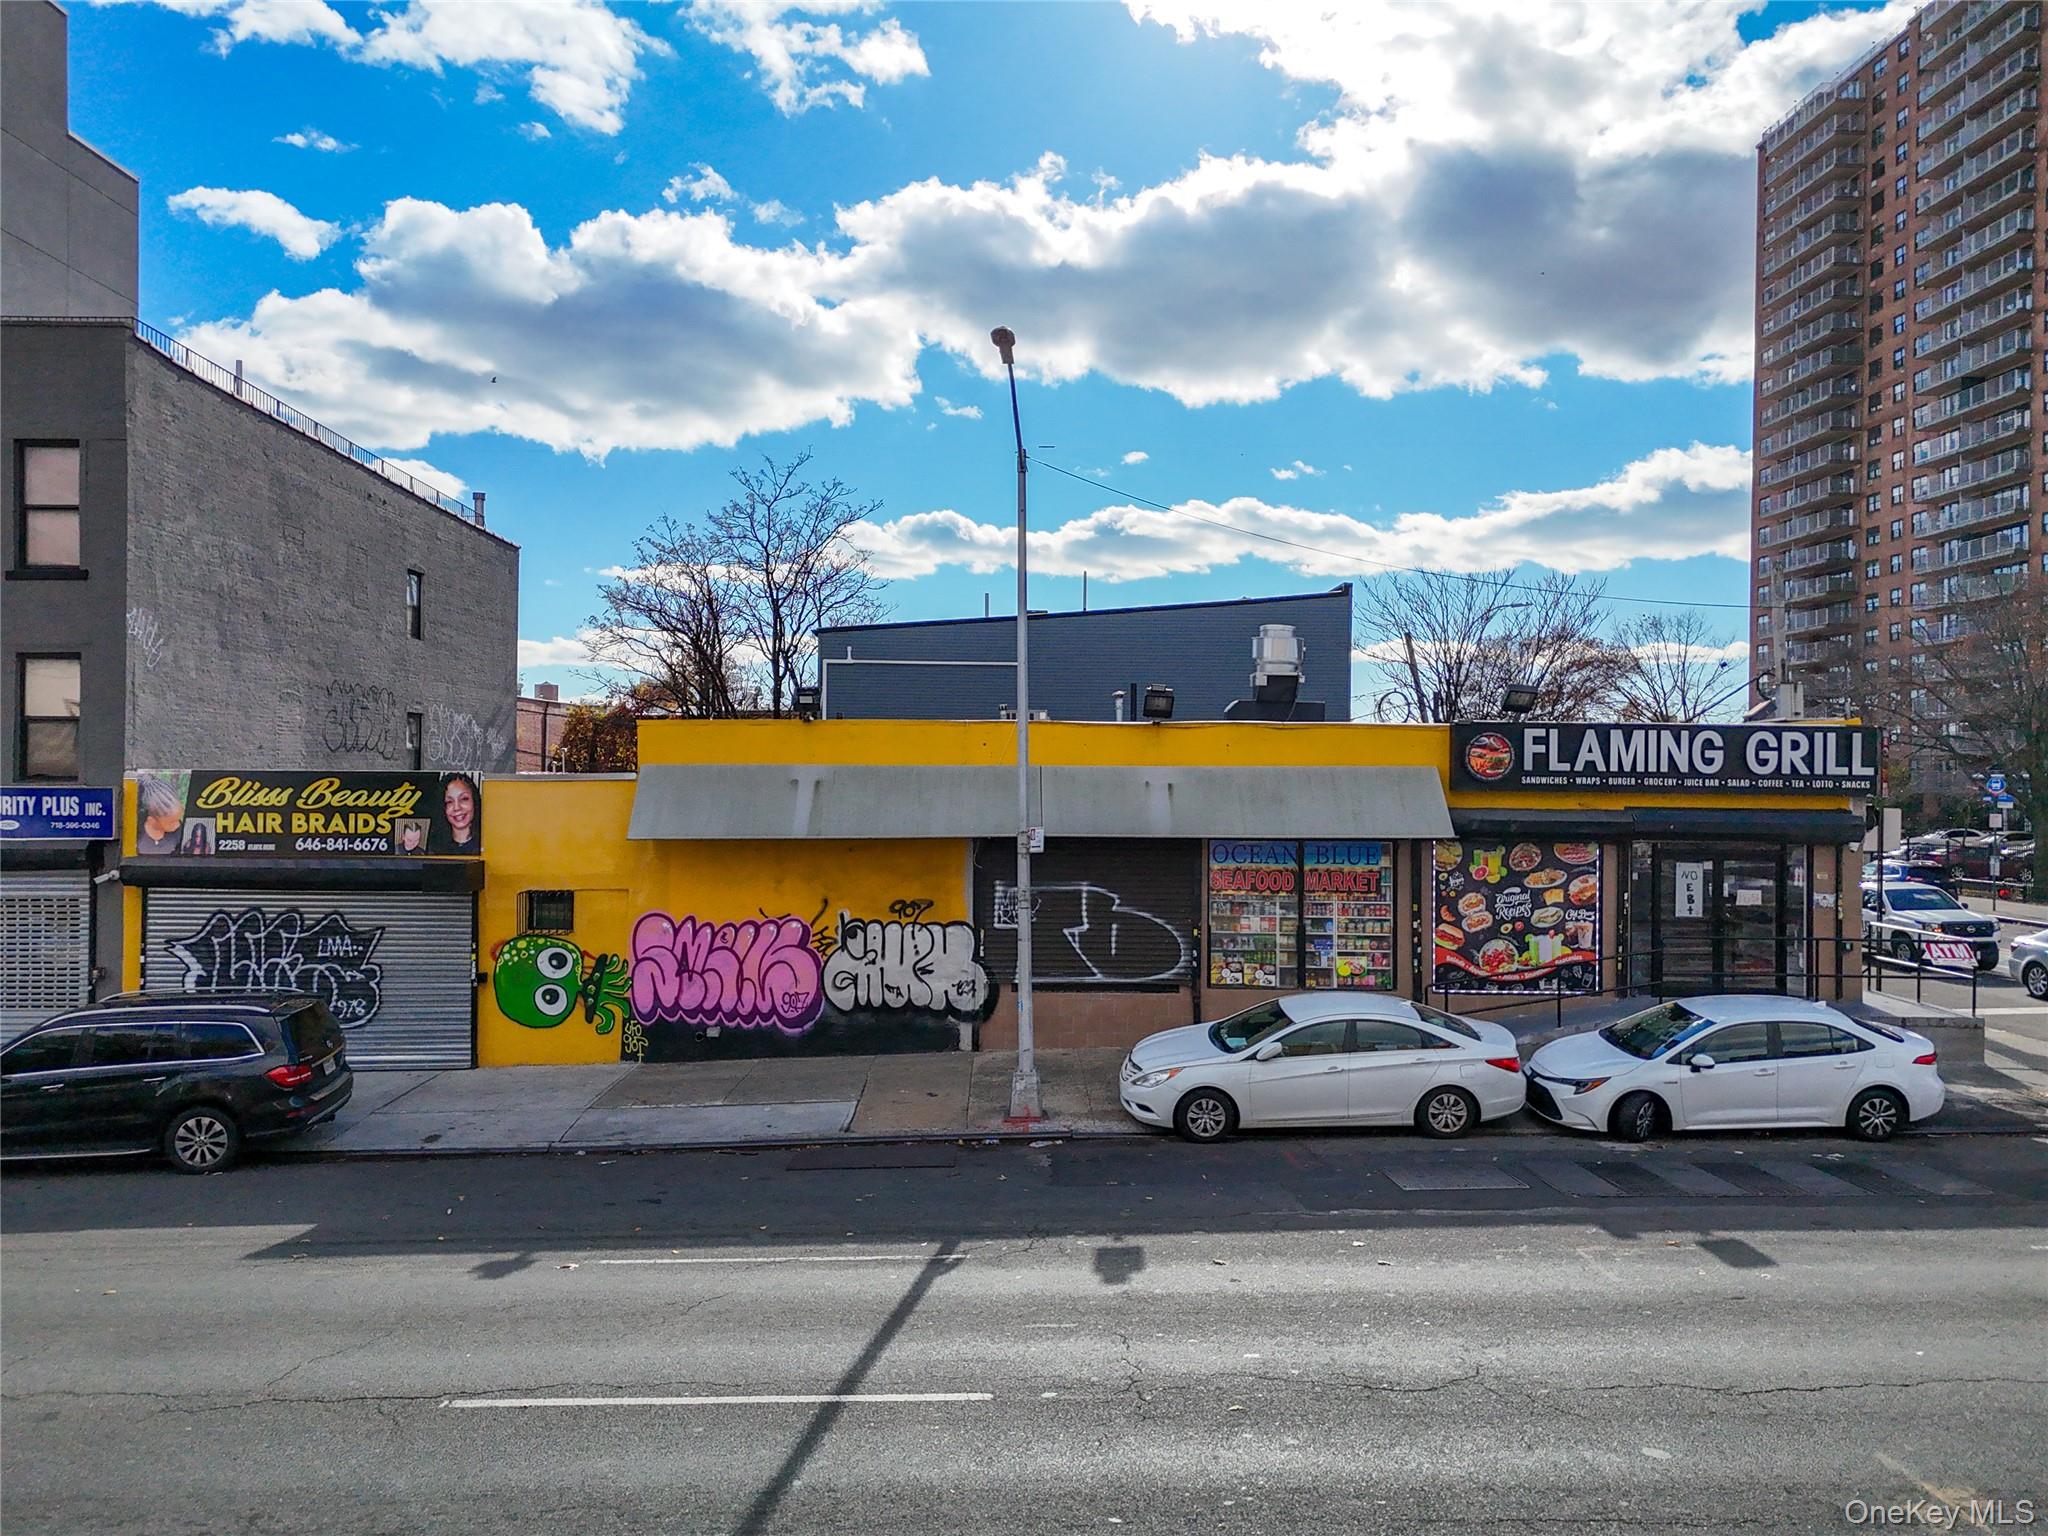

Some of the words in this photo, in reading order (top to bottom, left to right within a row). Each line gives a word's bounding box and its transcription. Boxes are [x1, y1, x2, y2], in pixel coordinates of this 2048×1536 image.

[1522, 728, 1725, 775] FLAMING
[1745, 730, 1875, 777] GRILL
[1521, 776, 1568, 785] SANDWICHES
[1575, 777, 1601, 785] WRAPS
[1608, 777, 1636, 786] BURGER
[1643, 778, 1677, 786] GROCERY
[1683, 778, 1703, 787] JUICE
[1705, 779, 1719, 787] BAR
[1727, 779, 1750, 787] SALAD
[1758, 779, 1784, 788] COFFEE
[1791, 779, 1805, 788] TEA
[1812, 780, 1834, 788] LOTTO
[1841, 780, 1871, 789] SNACKS
[41, 795, 80, 817] PLUS
[84, 801, 107, 817] INC.
[296, 777, 423, 818] Beauty
[215, 812, 283, 834] HAIR
[291, 812, 392, 835] BRAIDS
[218, 839, 246, 851] 2258
[295, 837, 388, 851] 646-841-6676
[1212, 843, 1298, 865] OCEAN
[1314, 844, 1380, 866] BLUE
[1211, 870, 1295, 891] SEAFOOD
[1303, 871, 1380, 892] MARKET
[1681, 870, 1698, 881] NO
[1495, 903, 1532, 920] Recipes
[1930, 943, 1972, 959] ATM
